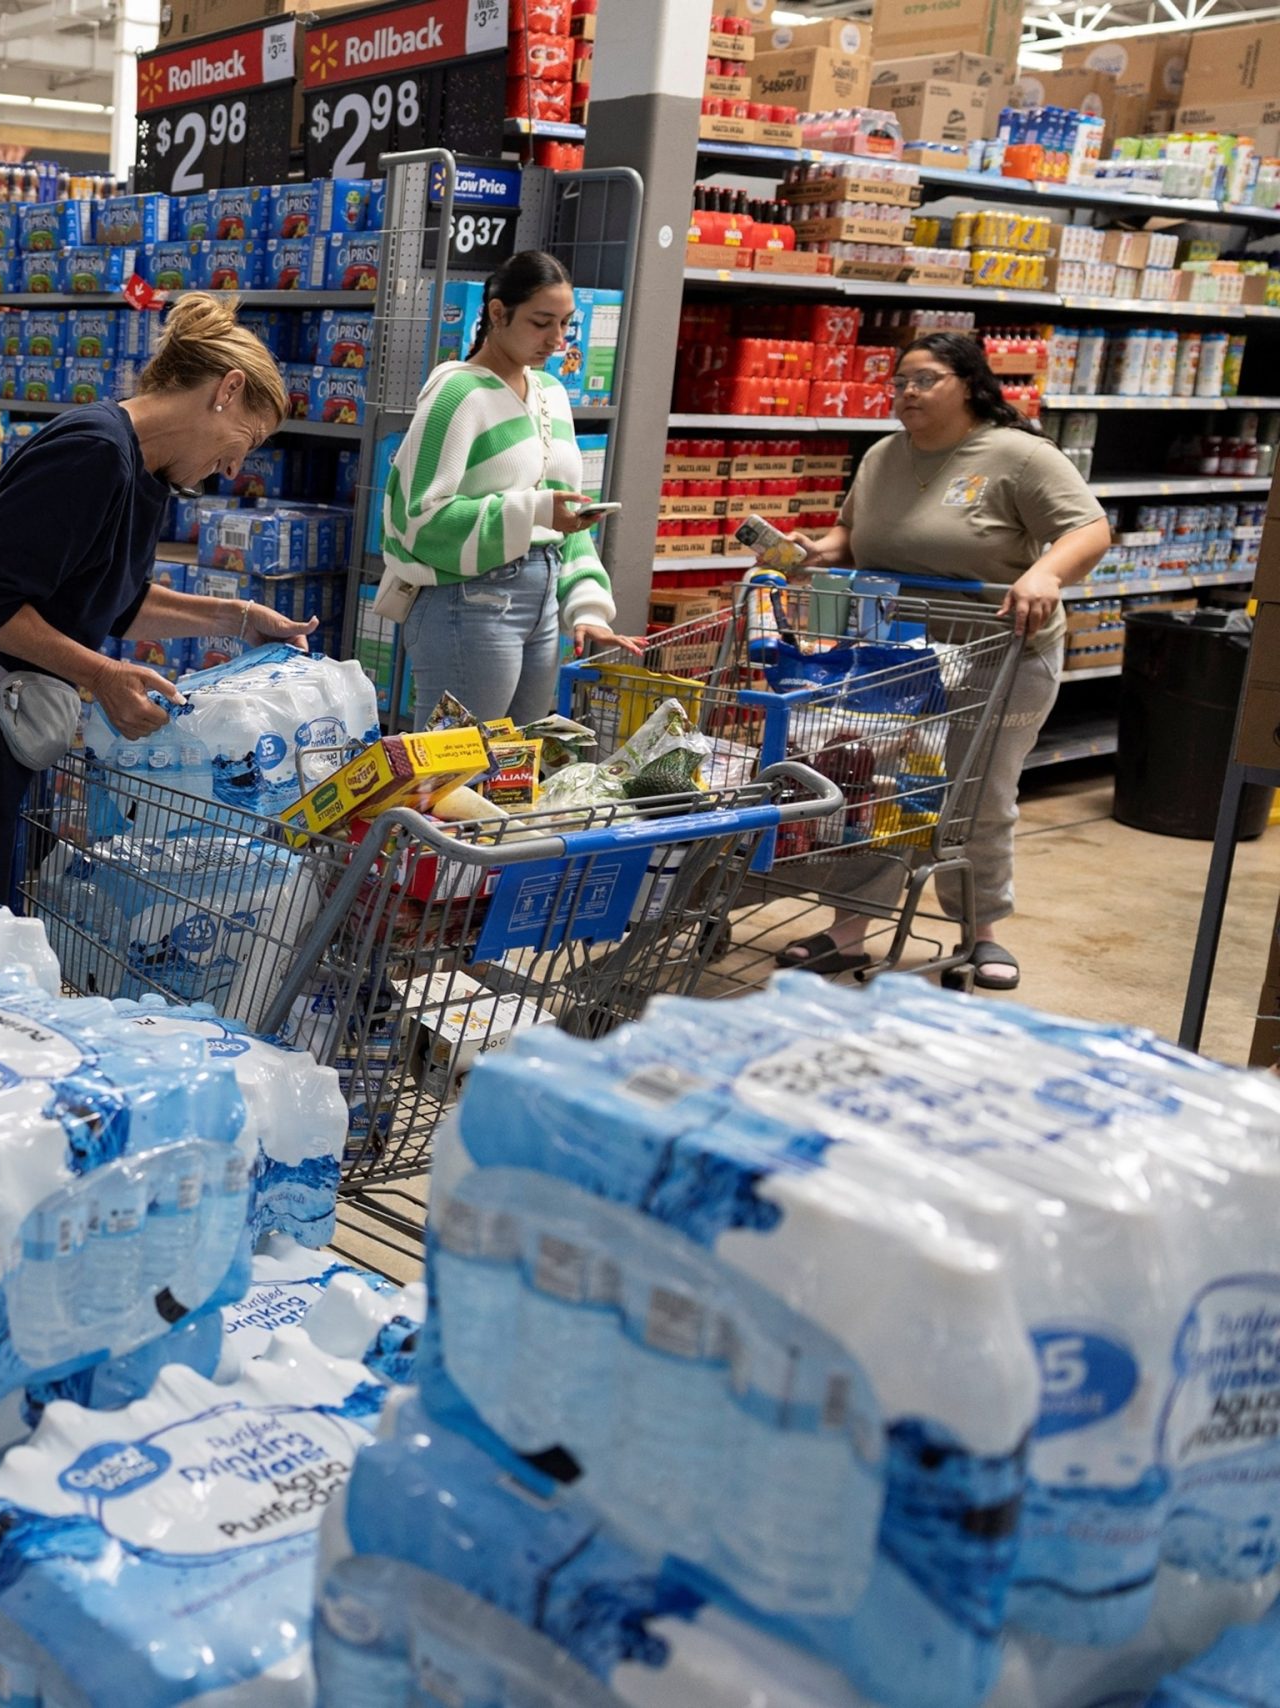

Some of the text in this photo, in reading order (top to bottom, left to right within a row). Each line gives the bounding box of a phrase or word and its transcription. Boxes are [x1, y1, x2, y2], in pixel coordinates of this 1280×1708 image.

[345, 16, 443, 66] Rollback
[168, 49, 246, 92] Rollback
[454, 177, 507, 195] Low Price
[232, 1285, 287, 1312] Purified
[179, 1432, 314, 1483] Drinking
[237, 1448, 331, 1483] Water
[272, 1460, 350, 1495] Agua
